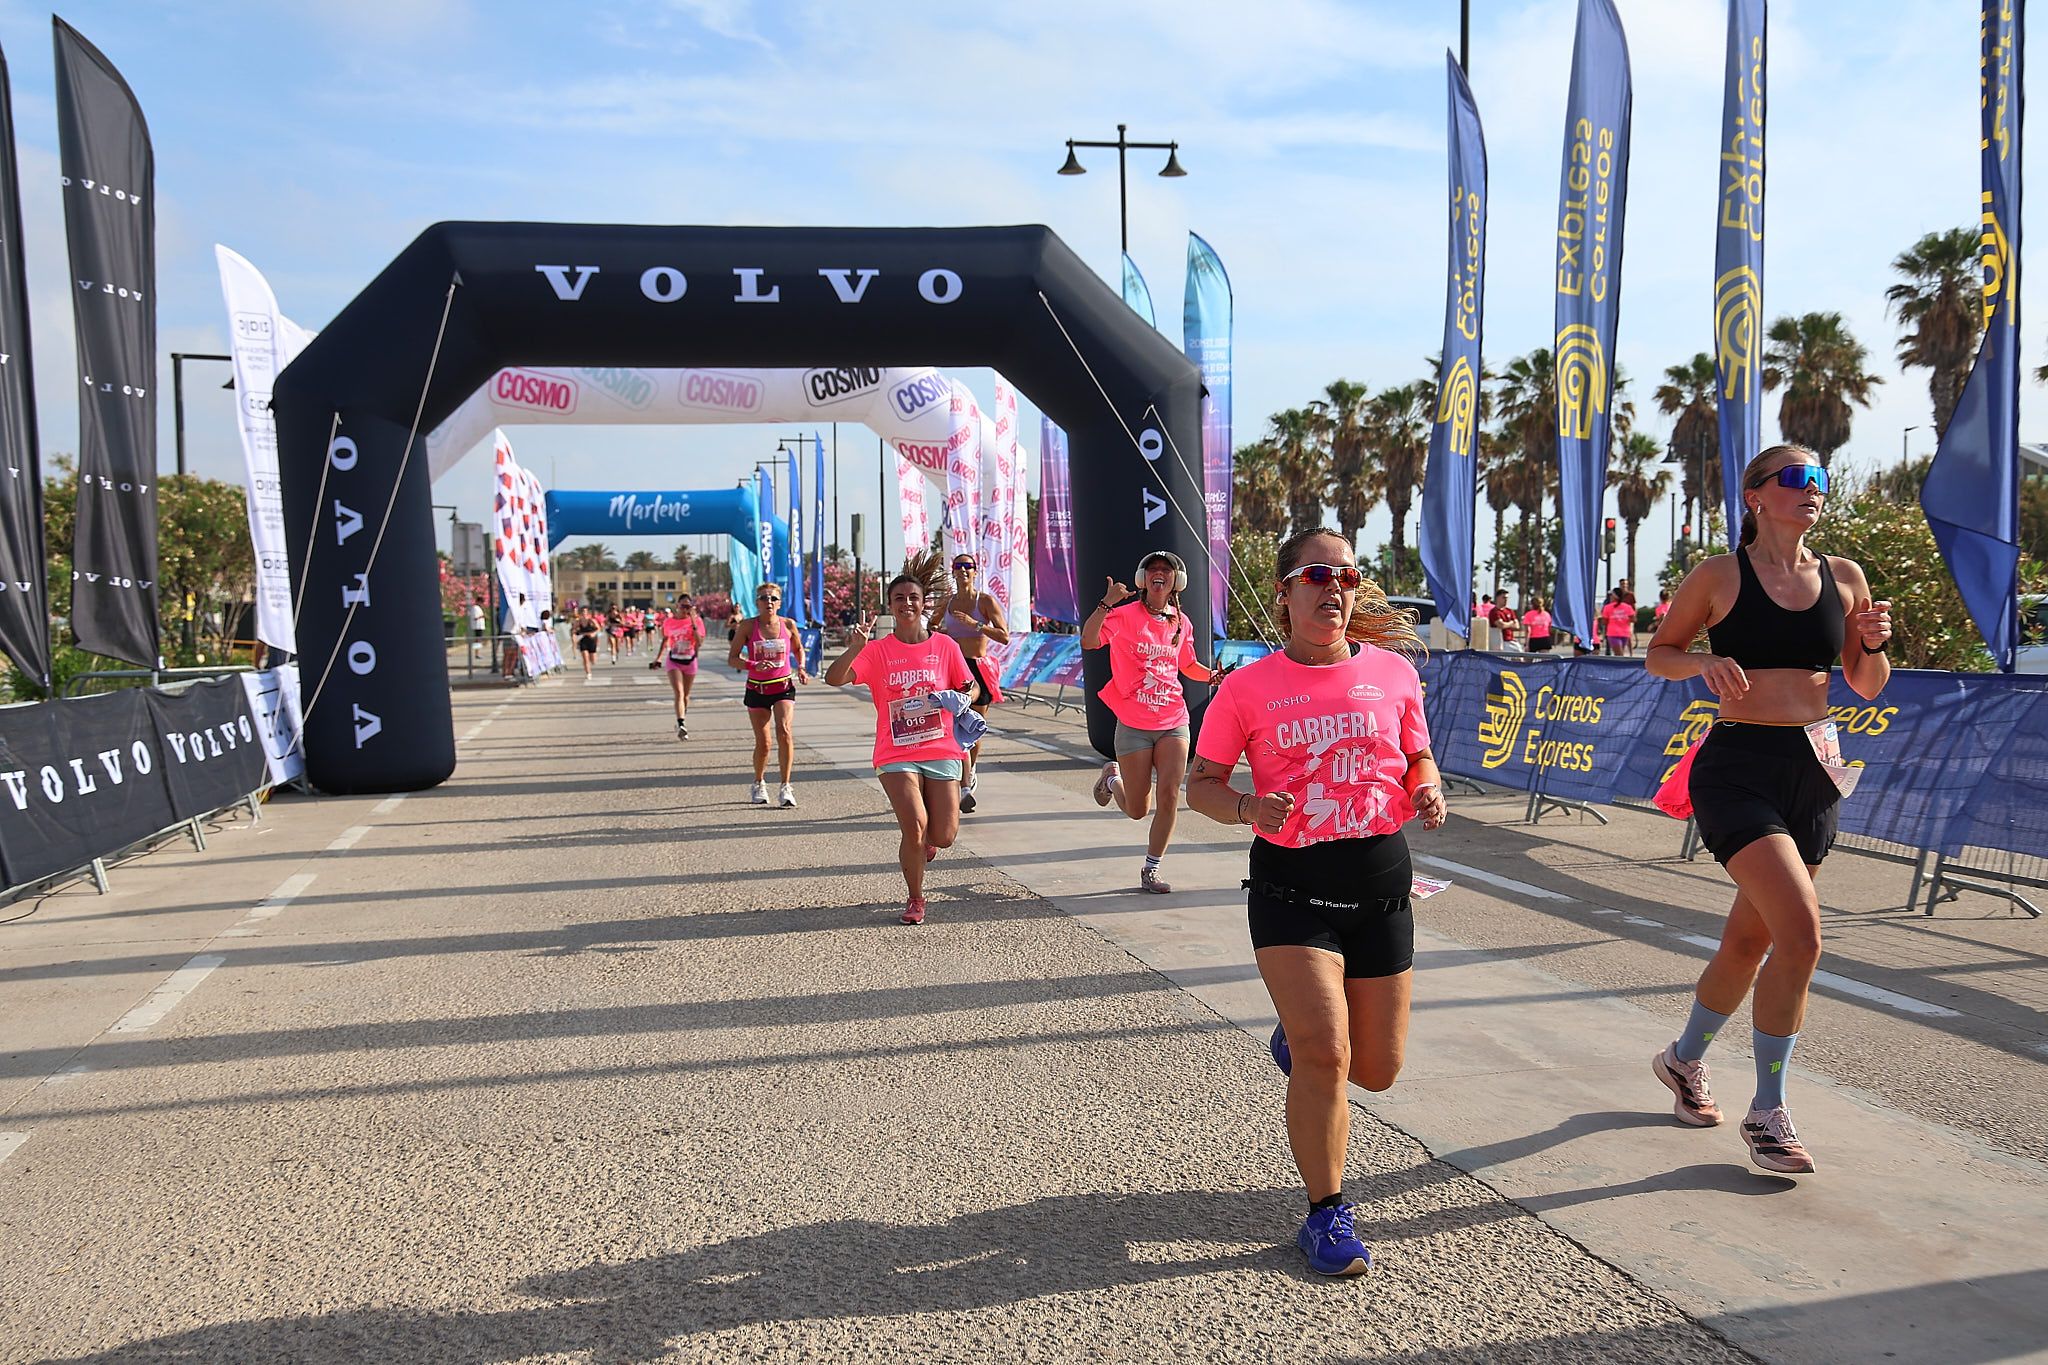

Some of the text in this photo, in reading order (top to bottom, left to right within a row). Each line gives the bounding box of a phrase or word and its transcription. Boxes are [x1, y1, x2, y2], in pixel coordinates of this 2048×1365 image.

[534, 264, 964, 304] VOLVO
[497, 371, 571, 410] COSMO
[686, 374, 758, 409] COSMO
[811, 367, 880, 401] COSMO
[896, 373, 951, 414] COSM
[898, 442, 948, 471] COSM
[330, 435, 383, 750] VOLVO
[906, 716, 926, 727] 016
[1266, 694, 1311, 711] OYSHO
[1535, 684, 1604, 725] Correos
[166, 714, 253, 764] VOLVO
[1523, 728, 1594, 774] Express
[0, 740, 152, 810] VOLVO
